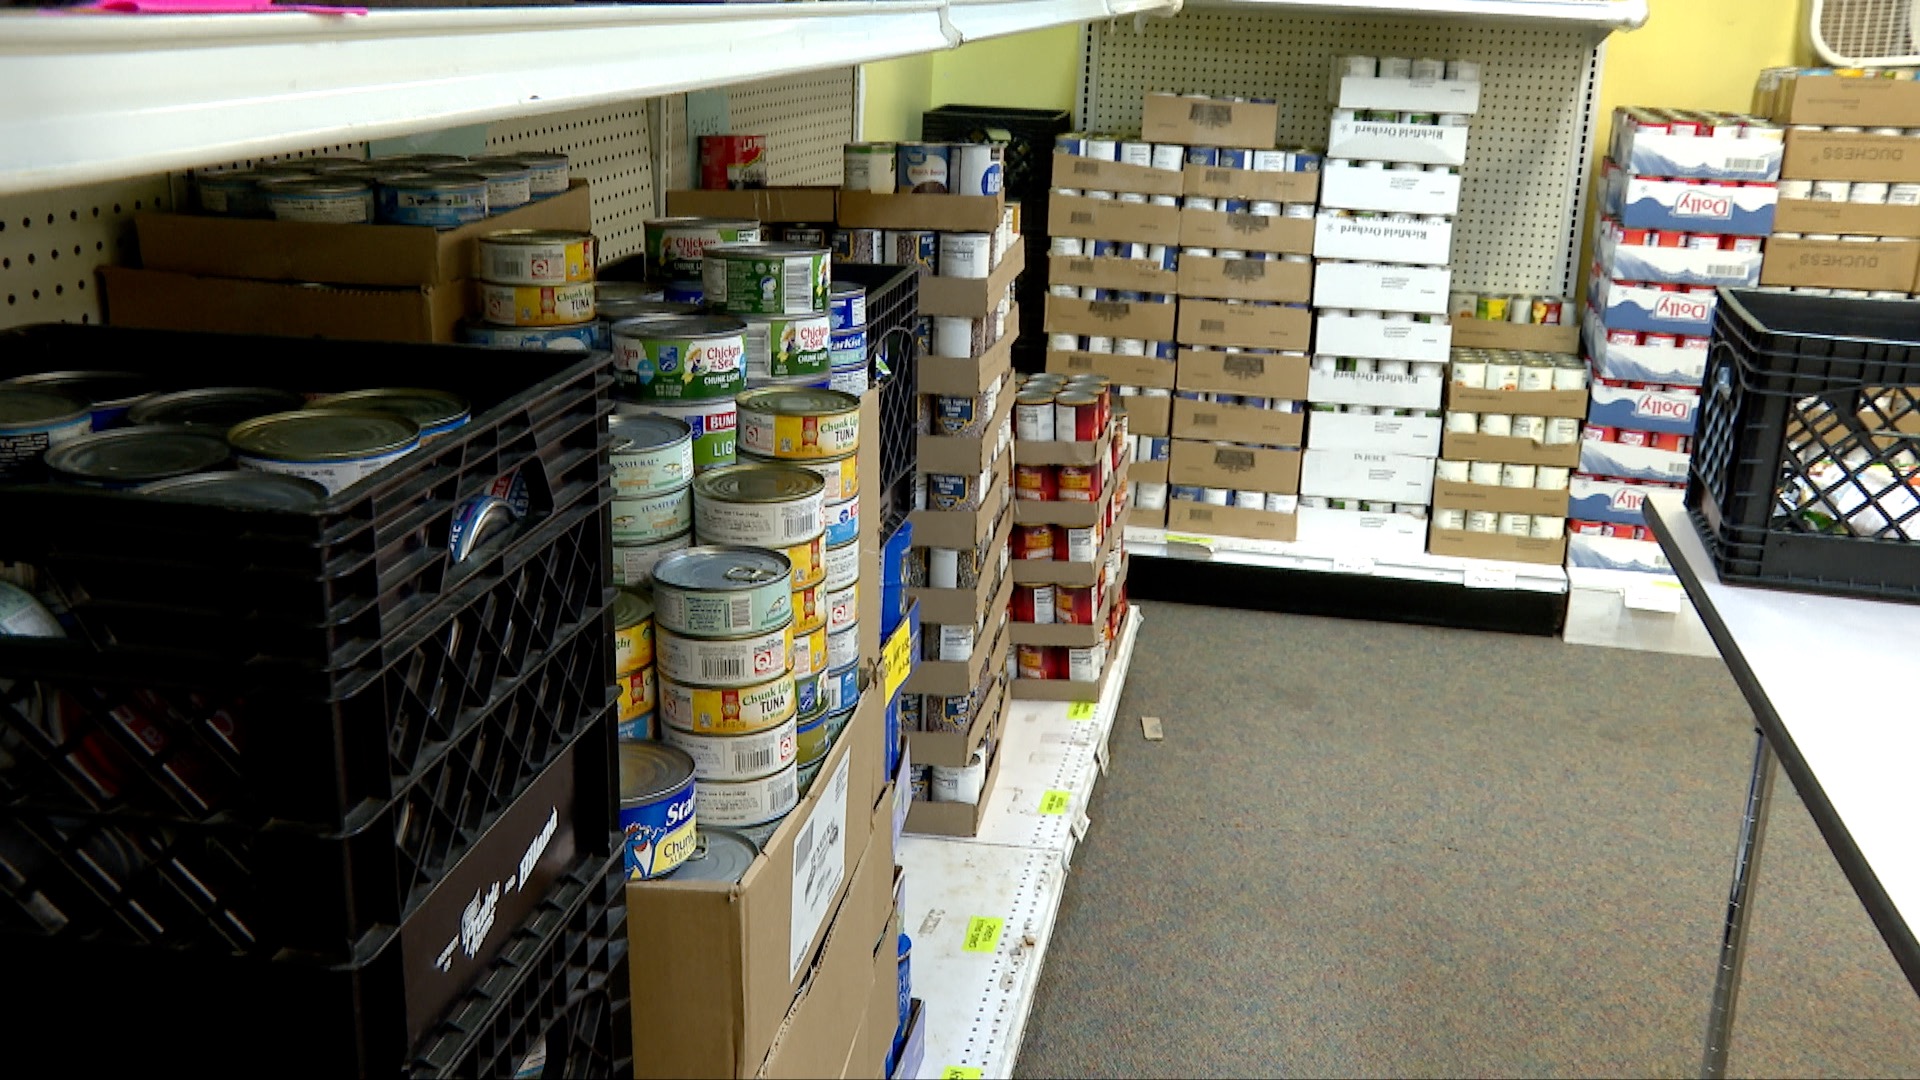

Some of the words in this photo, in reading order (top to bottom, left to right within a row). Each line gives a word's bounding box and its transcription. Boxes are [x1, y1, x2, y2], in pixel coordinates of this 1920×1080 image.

[1354, 123, 1397, 138] Orchard
[1399, 125, 1443, 140] Richfield
[1823, 146, 1904, 162] DUCHESS
[1679, 193, 1729, 215] Dolly
[1340, 224, 1381, 238] Orchard
[1383, 225, 1428, 240] Richfield
[1799, 253, 1879, 269] DUCHESS
[571, 298, 590, 311] TUNA
[1658, 297, 1707, 319] Dolly
[707, 345, 741, 360] Chicken
[717, 359, 734, 370] Sea
[704, 374, 725, 385] CHUNK
[726, 371, 740, 382] LIGHT
[1641, 395, 1689, 419] Dolly
[820, 417, 848, 434] Chunk
[835, 427, 855, 442] TUNA
[1617, 490, 1643, 509] olly
[615, 637, 632, 651] ght
[742, 687, 776, 706] Chunk
[760, 695, 785, 714] TUNA
